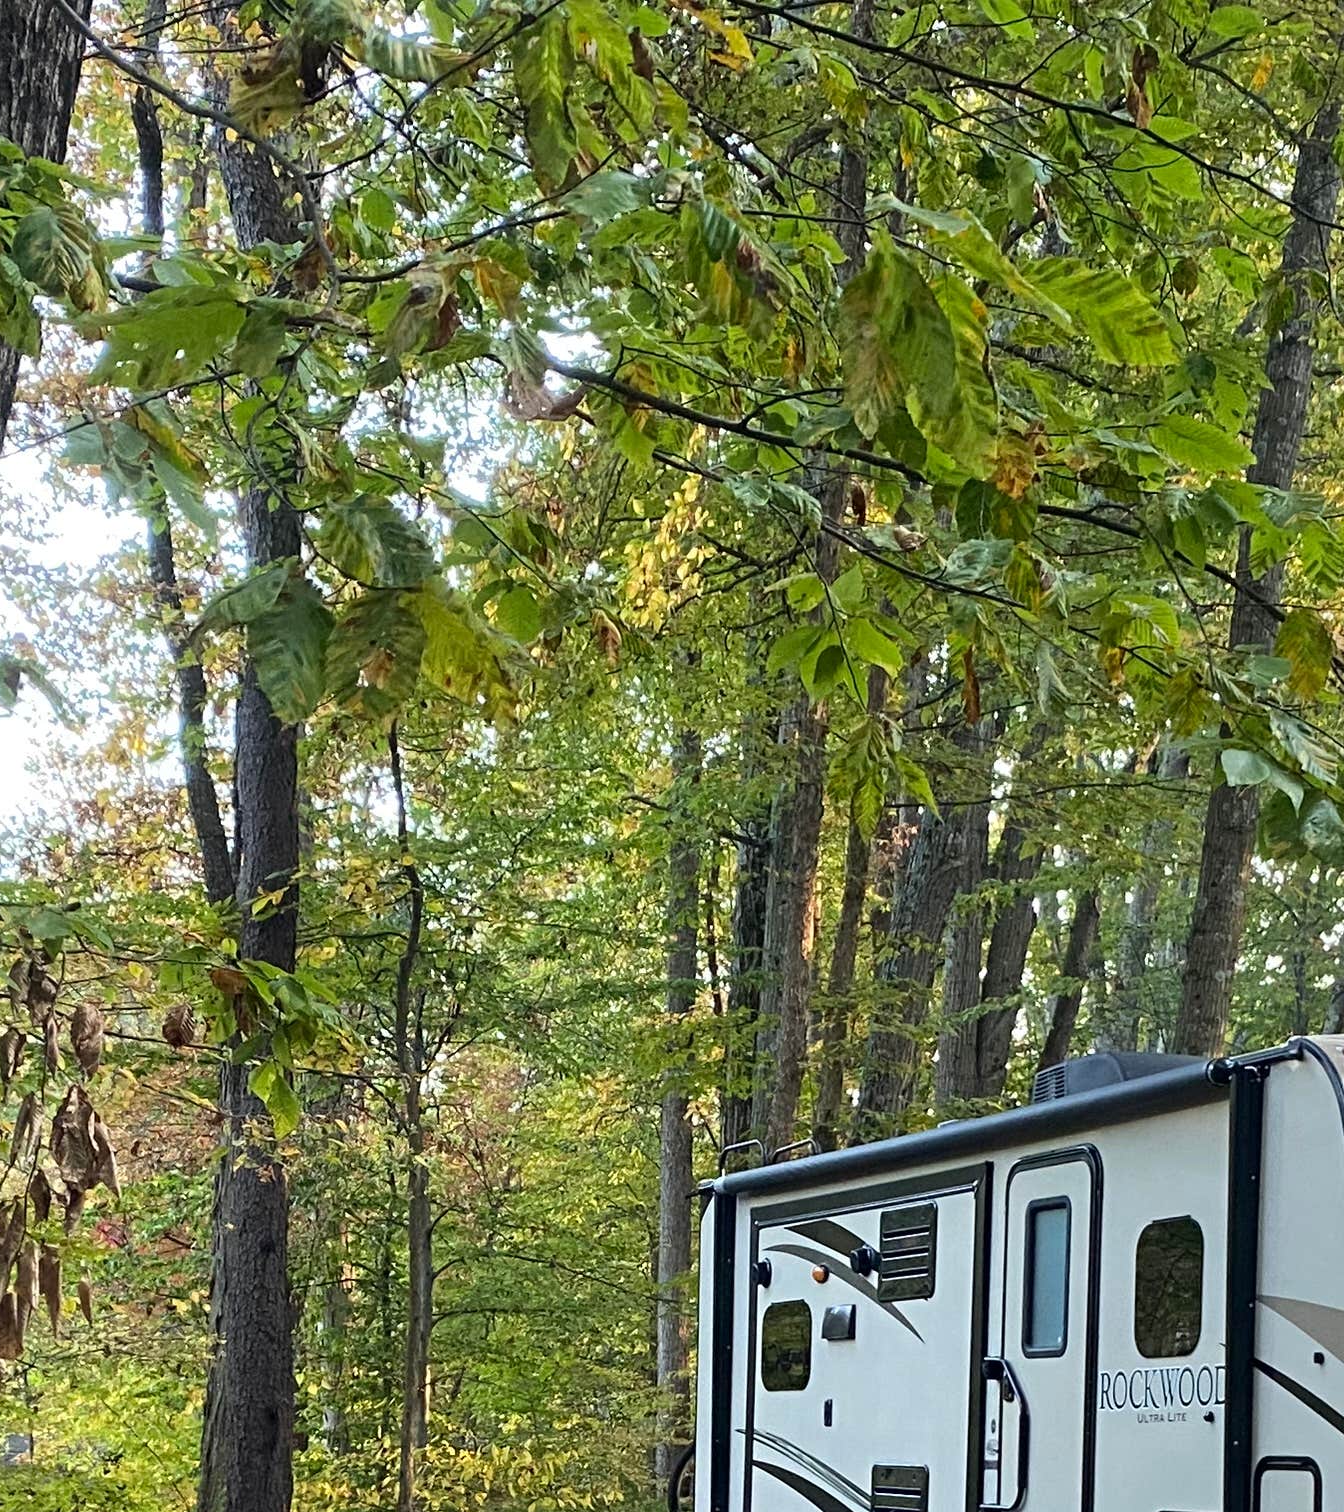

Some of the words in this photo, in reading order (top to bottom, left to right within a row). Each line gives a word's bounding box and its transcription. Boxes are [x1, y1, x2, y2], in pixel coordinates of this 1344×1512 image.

[1099, 1365, 1227, 1411] ROCKWOOD
[1136, 1412, 1165, 1424] ULTRA
[1167, 1411, 1187, 1423] LITE
